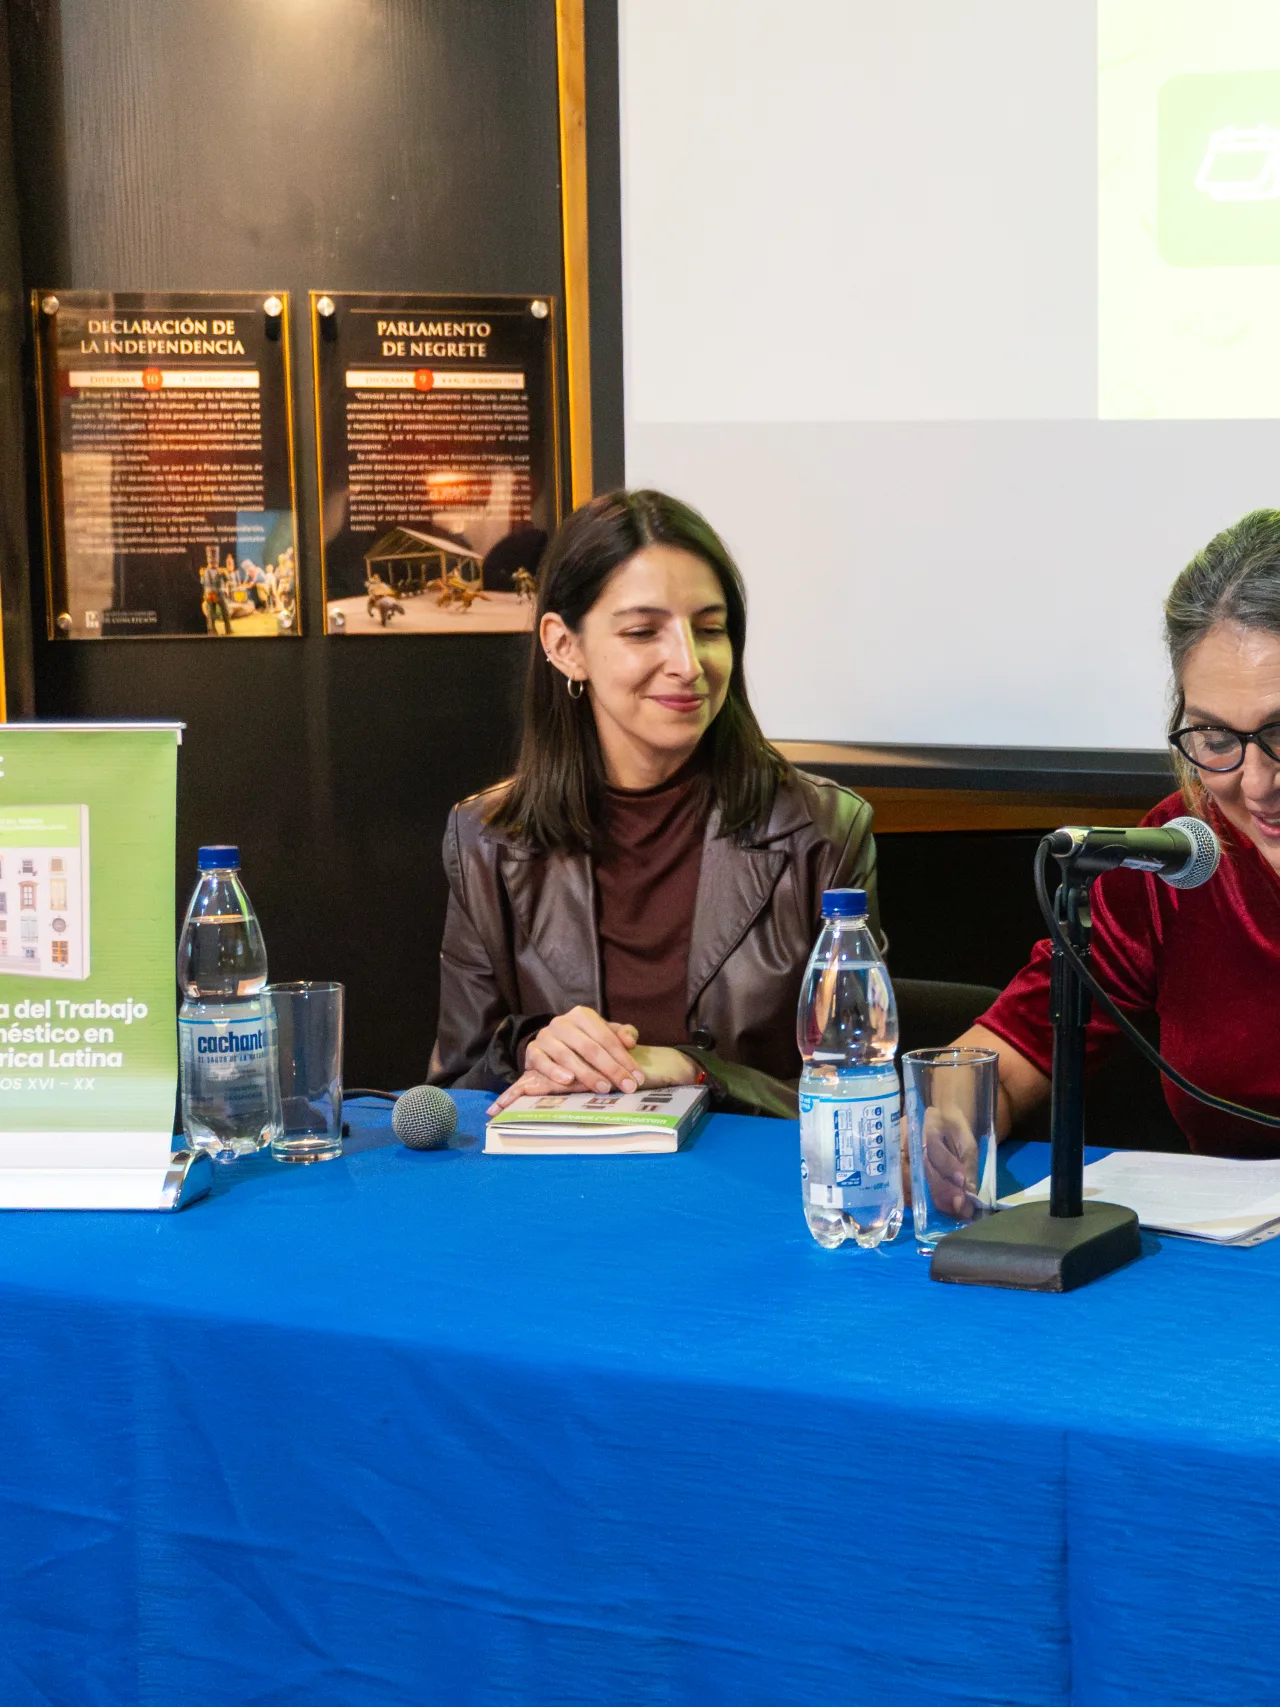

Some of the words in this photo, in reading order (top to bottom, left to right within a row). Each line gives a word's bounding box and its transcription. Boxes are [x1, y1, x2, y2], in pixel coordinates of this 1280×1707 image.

[88, 317, 208, 335] DECLARACIÓN
[212, 320, 236, 335] DE
[377, 321, 491, 337] PARLAMENTO
[81, 340, 99, 354] LA
[103, 340, 246, 355] INDEPENDENCIA
[382, 342, 405, 357] DE
[410, 342, 488, 358] NEGRETE
[14, 999, 51, 1019] del
[55, 998, 148, 1025] Trabajo
[83, 1027, 114, 1043] en
[49, 1047, 123, 1067] Latina
[27, 1078, 55, 1090] XVI
[73, 1078, 96, 1090] XX
